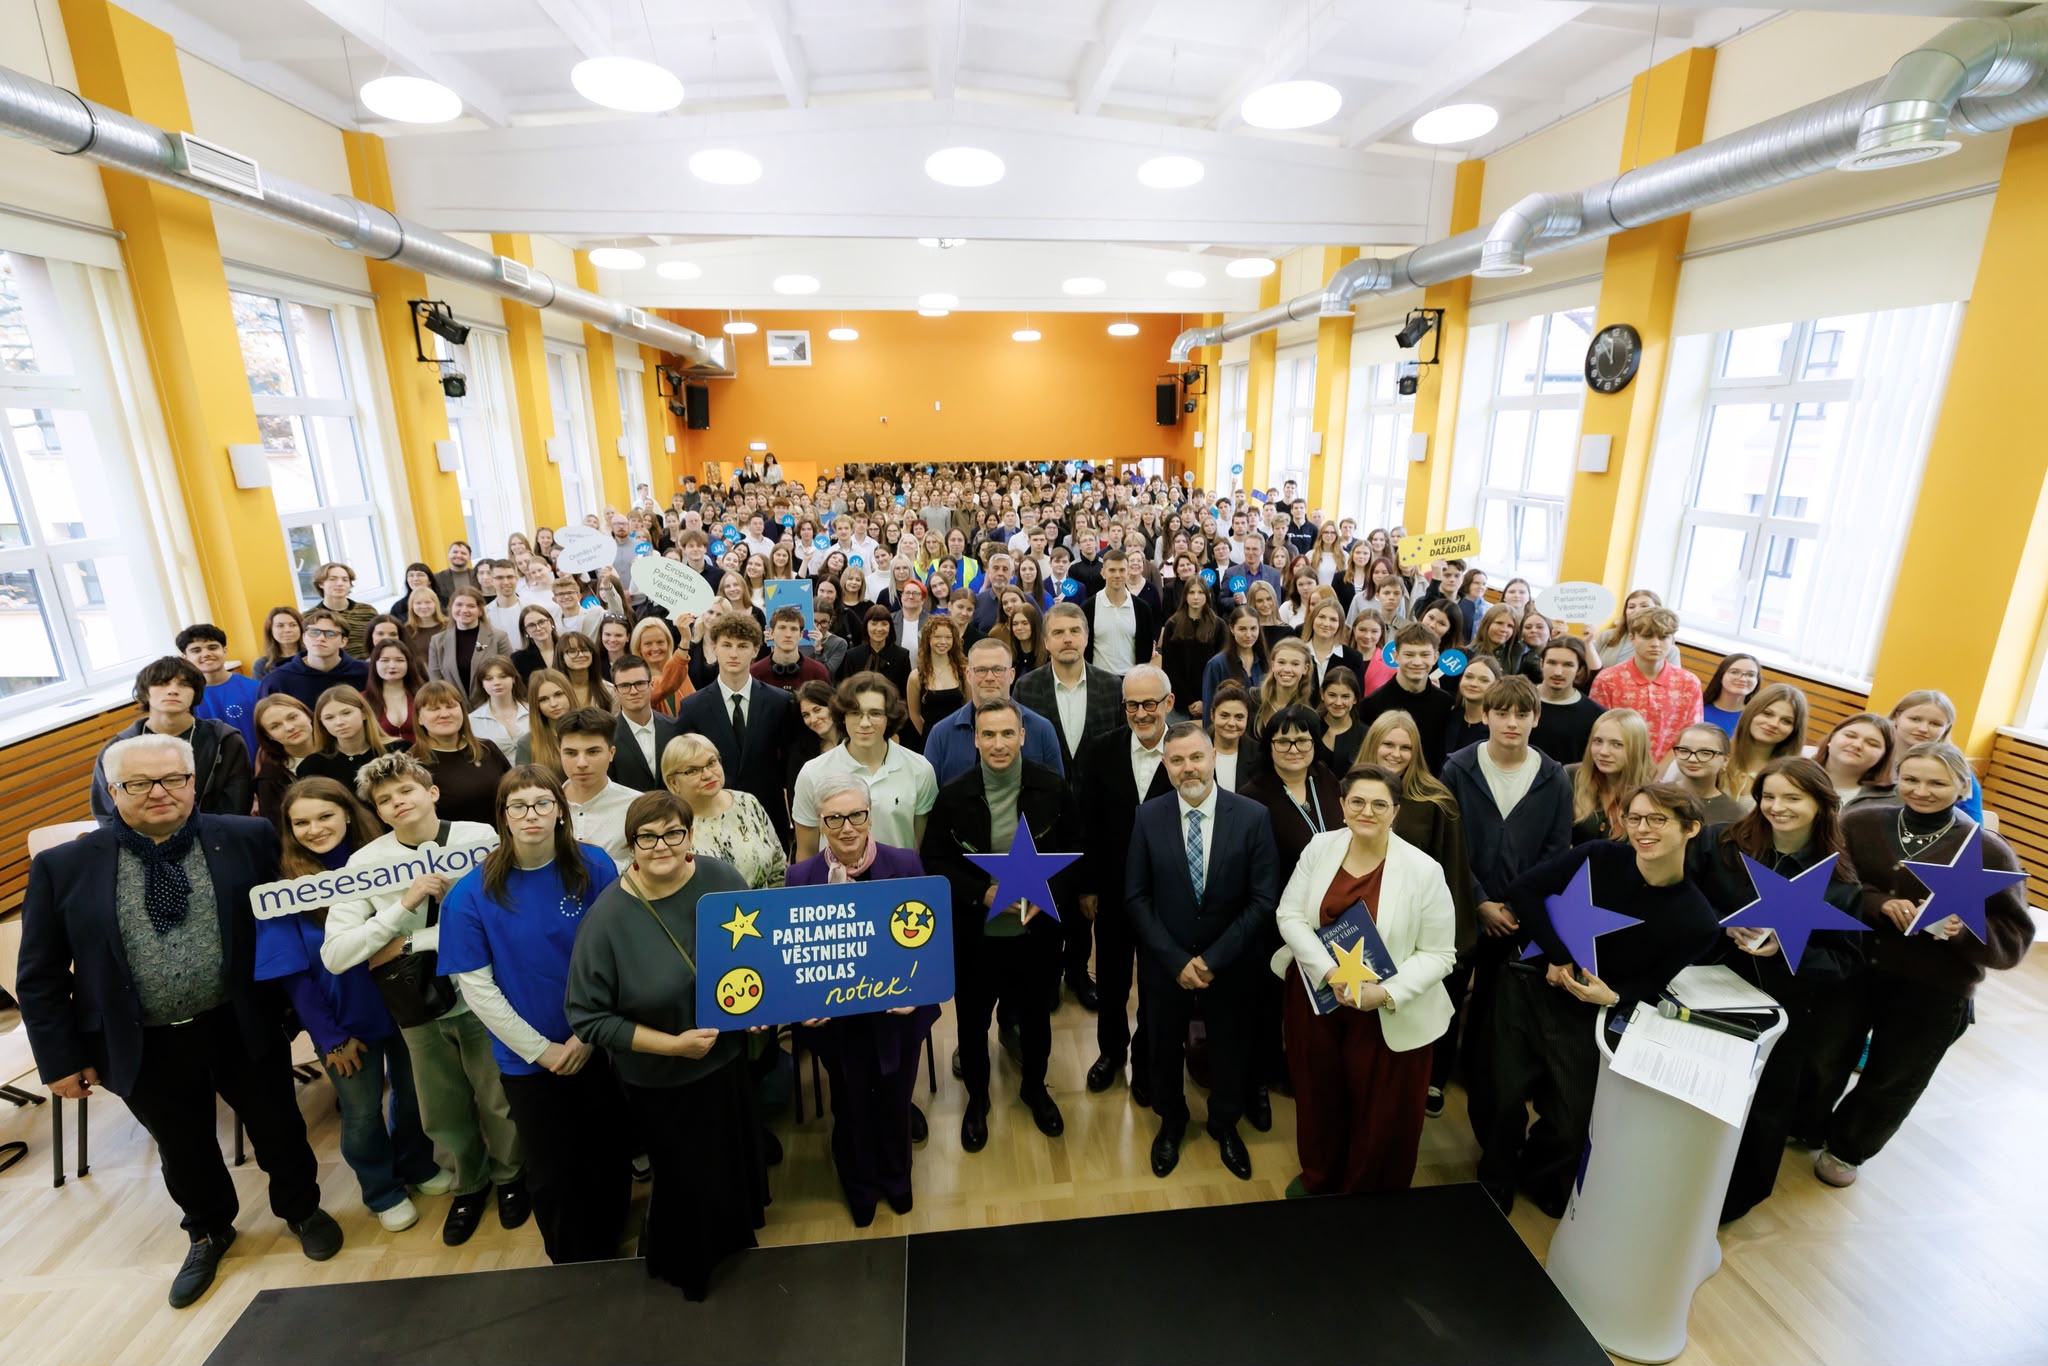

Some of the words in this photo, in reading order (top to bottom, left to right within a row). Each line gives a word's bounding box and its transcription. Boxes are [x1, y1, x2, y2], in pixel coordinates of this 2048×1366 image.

[1433, 534, 1465, 546] VIENOTI
[653, 567, 697, 594] Parlamenta
[664, 563, 693, 582] Eiropas
[652, 579, 689, 601] Vēstnieku
[1062, 583, 1076, 594] JĀ!
[1233, 578, 1245, 591] JĀ!
[655, 591, 678, 606] skola!
[1441, 655, 1462, 673] JĀ!
[258, 842, 500, 912] mesesamkop
[789, 902, 856, 924] EIROPAS
[772, 920, 876, 946] PARLAMENTA
[782, 940, 868, 965] VĒSTNIEKU
[795, 962, 856, 984] SKOLAS
[825, 960, 918, 1005] notiek!
